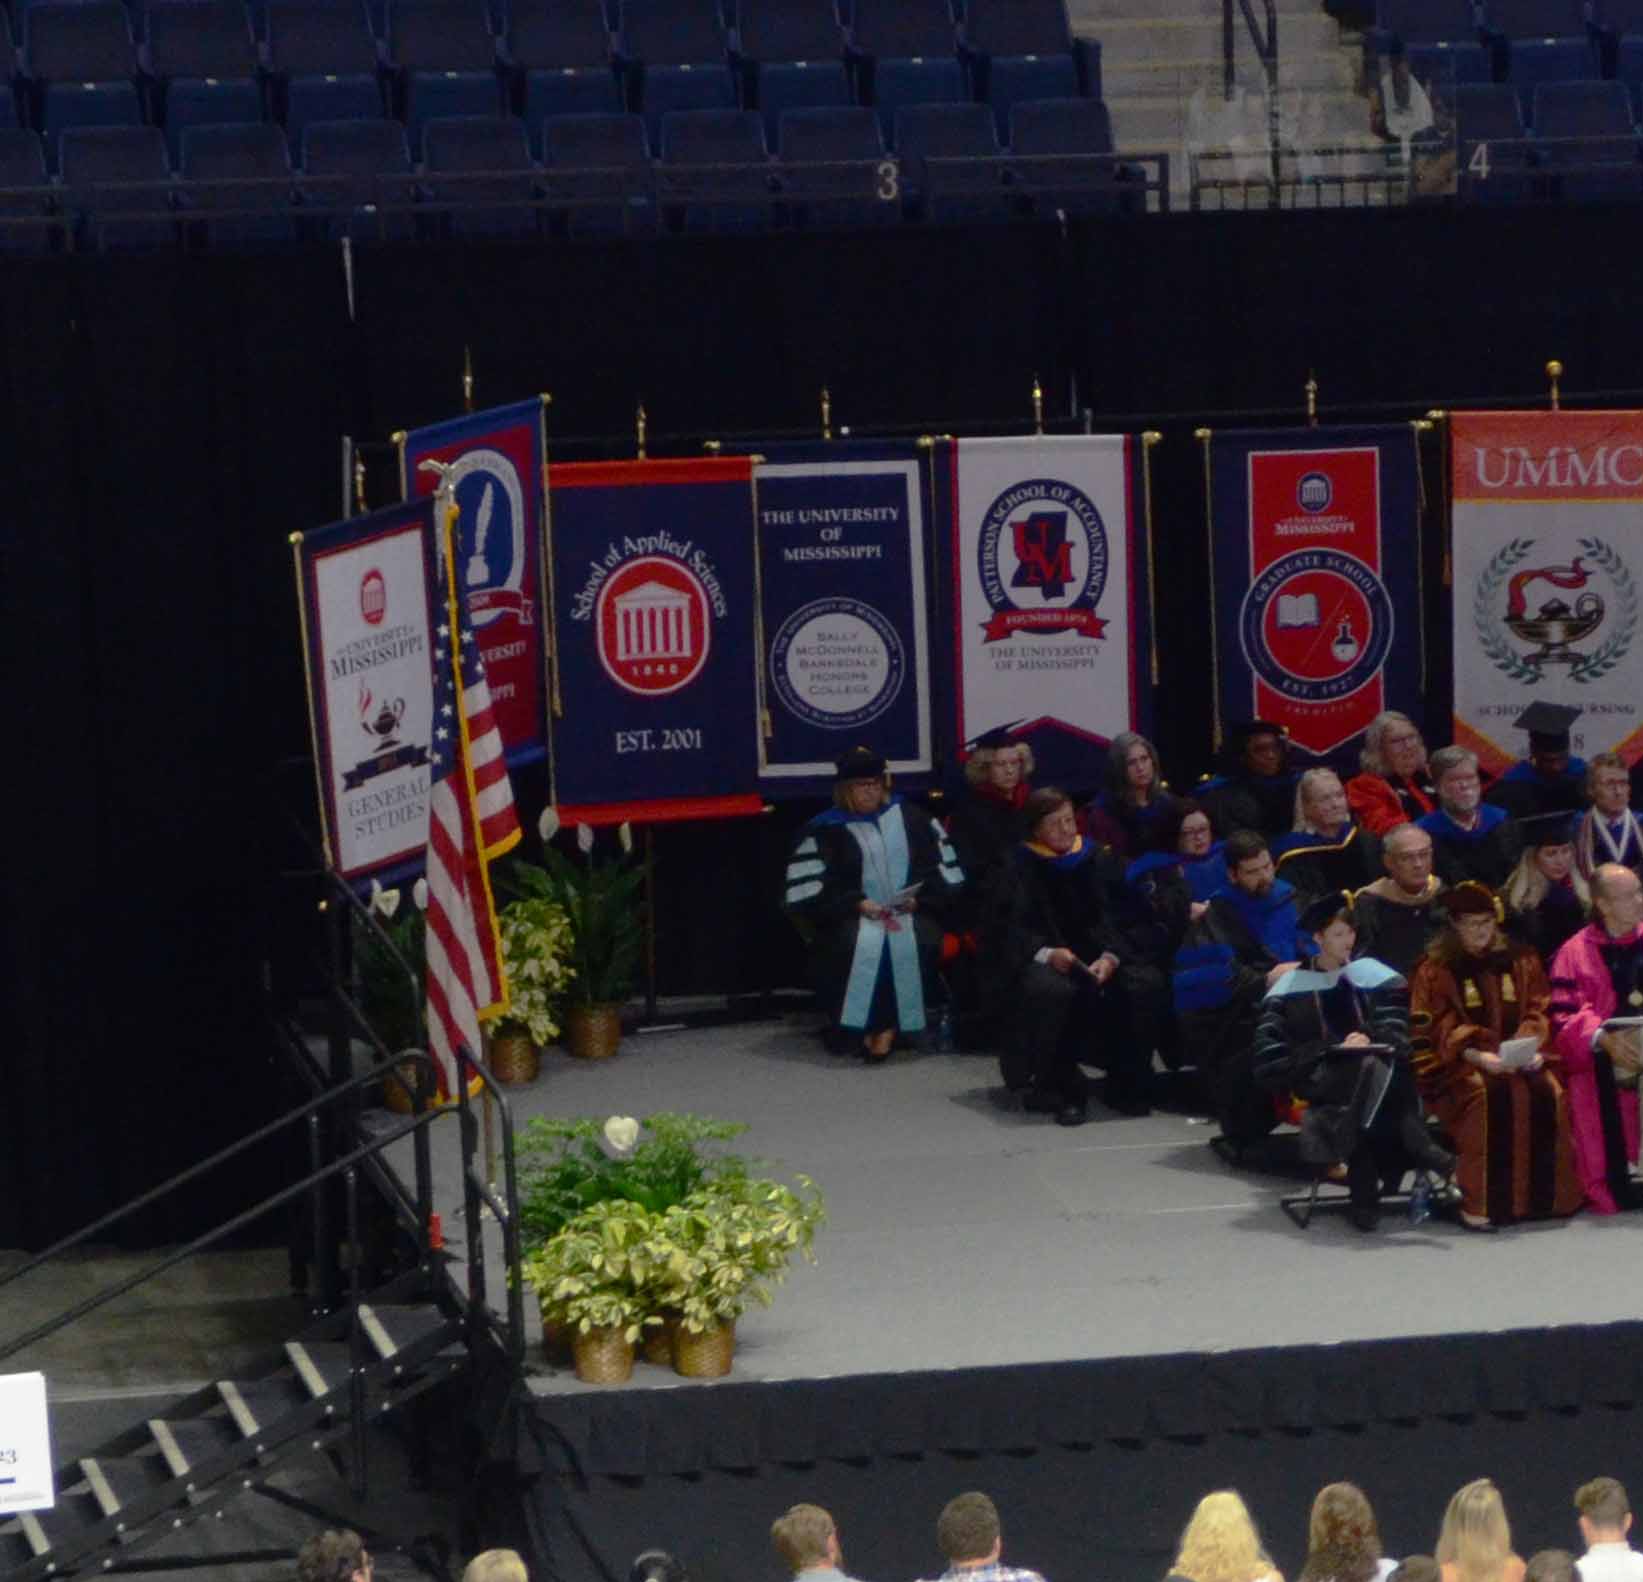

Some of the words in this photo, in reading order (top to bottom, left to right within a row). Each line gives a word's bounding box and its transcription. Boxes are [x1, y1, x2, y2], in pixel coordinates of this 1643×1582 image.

[1469, 143, 1492, 179] 4
[878, 161, 898, 200] 3
[763, 510, 794, 524] THE
[798, 507, 899, 523] UNIVERSITY
[819, 527, 843, 542] OF
[993, 484, 1050, 522] SCHOOL
[1051, 485, 1072, 499] OF
[1071, 497, 1106, 600] ACCOUNTANCY
[784, 545, 882, 562] MISSISSIPPI
[571, 561, 608, 621] School
[604, 542, 621, 567] of
[624, 529, 692, 559] Applied
[688, 550, 728, 618] Sciences
[1254, 555, 1323, 602] GRADUATE
[1327, 556, 1378, 598] SCHOOL
[330, 635, 423, 681] MISSISSIPPI
[990, 646, 1014, 659] THE
[1021, 644, 1101, 658] UNIVERSITY
[994, 659, 1012, 671] OF
[1018, 657, 1095, 672] MISSISSIPPI
[616, 730, 656, 753] EST.
[661, 728, 702, 750] 2001
[348, 777, 430, 817] GENERAL
[355, 802, 426, 840] STUDIES
